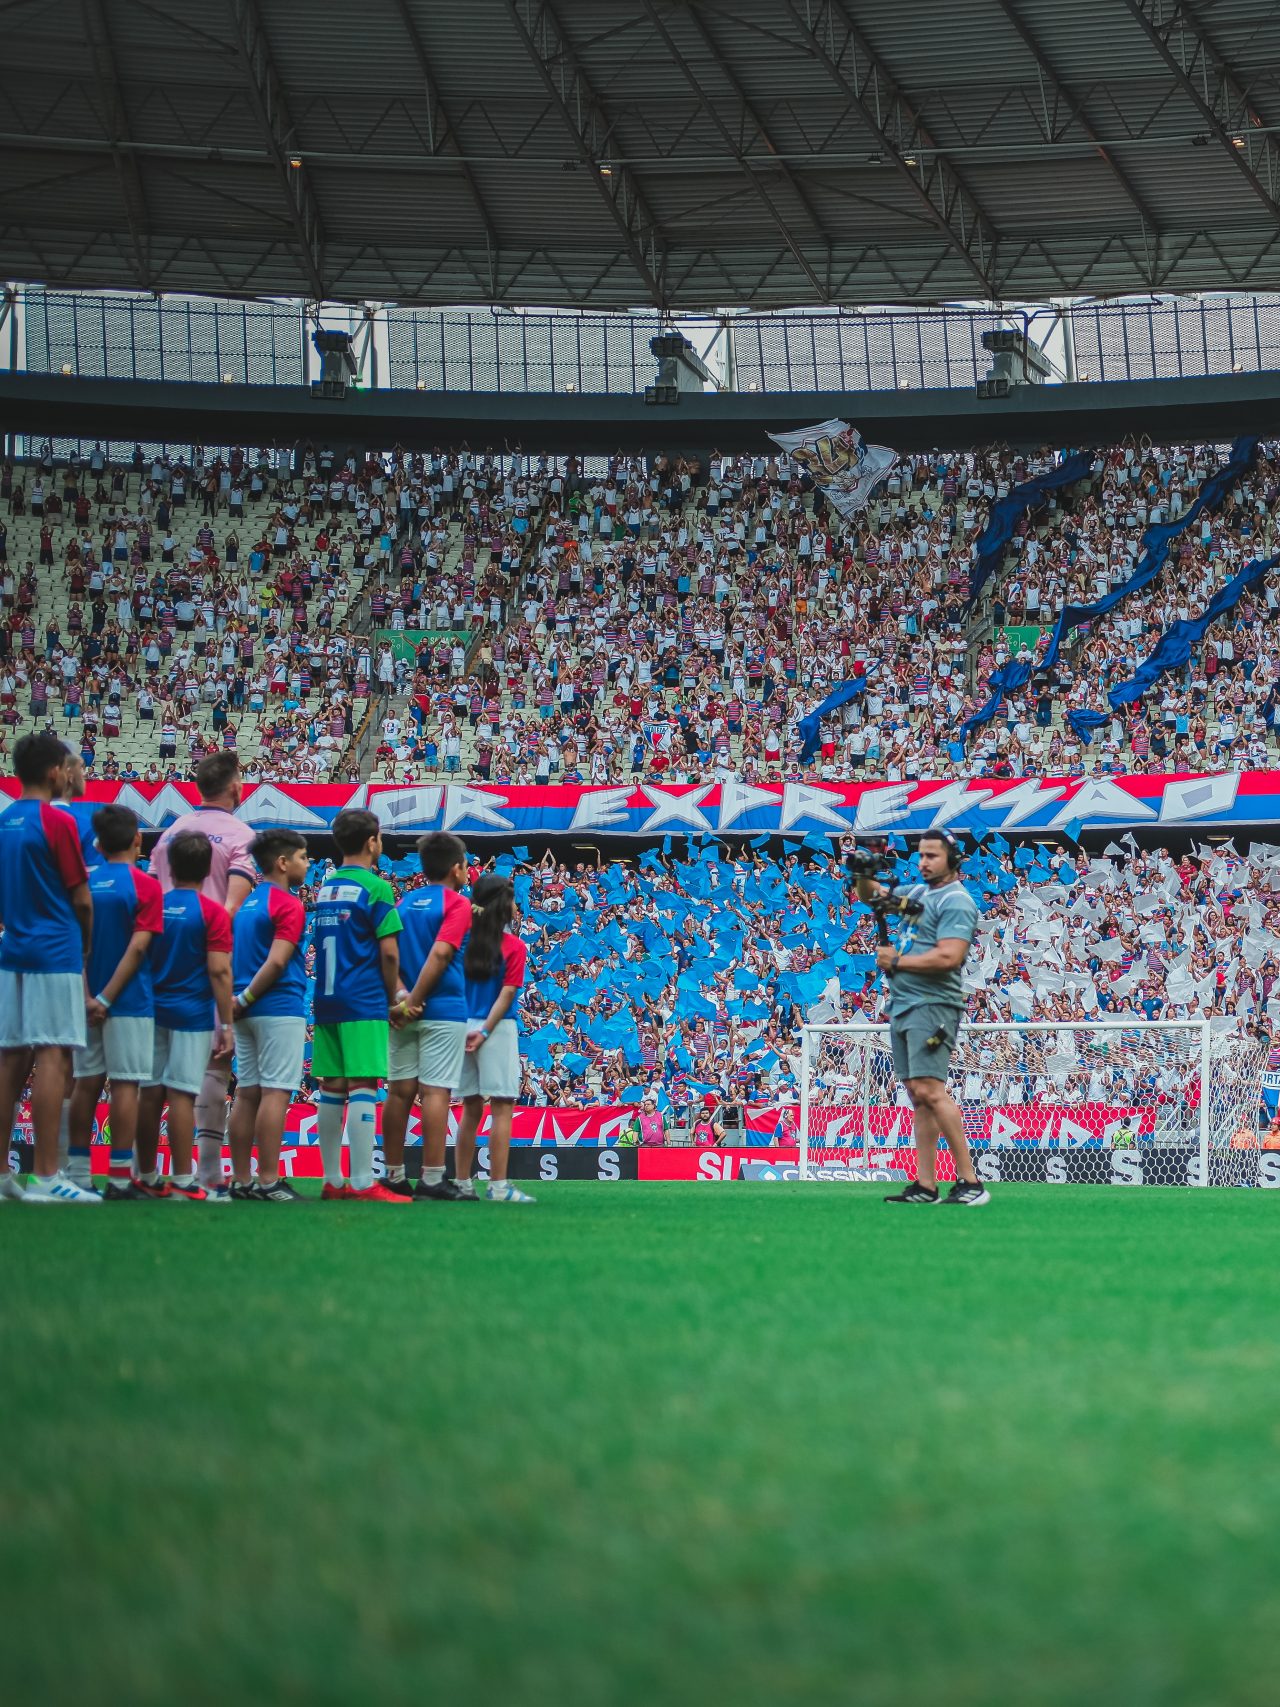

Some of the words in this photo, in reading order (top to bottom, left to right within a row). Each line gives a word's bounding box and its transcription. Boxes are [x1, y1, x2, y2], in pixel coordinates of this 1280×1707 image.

[108, 782, 517, 831] MAIOR
[322, 936, 336, 996] 1
[539, 1153, 558, 1181] S
[598, 1150, 620, 1181] S
[978, 1153, 1000, 1182] S
[1046, 1156, 1067, 1184] S
[1111, 1151, 1143, 1185] S
